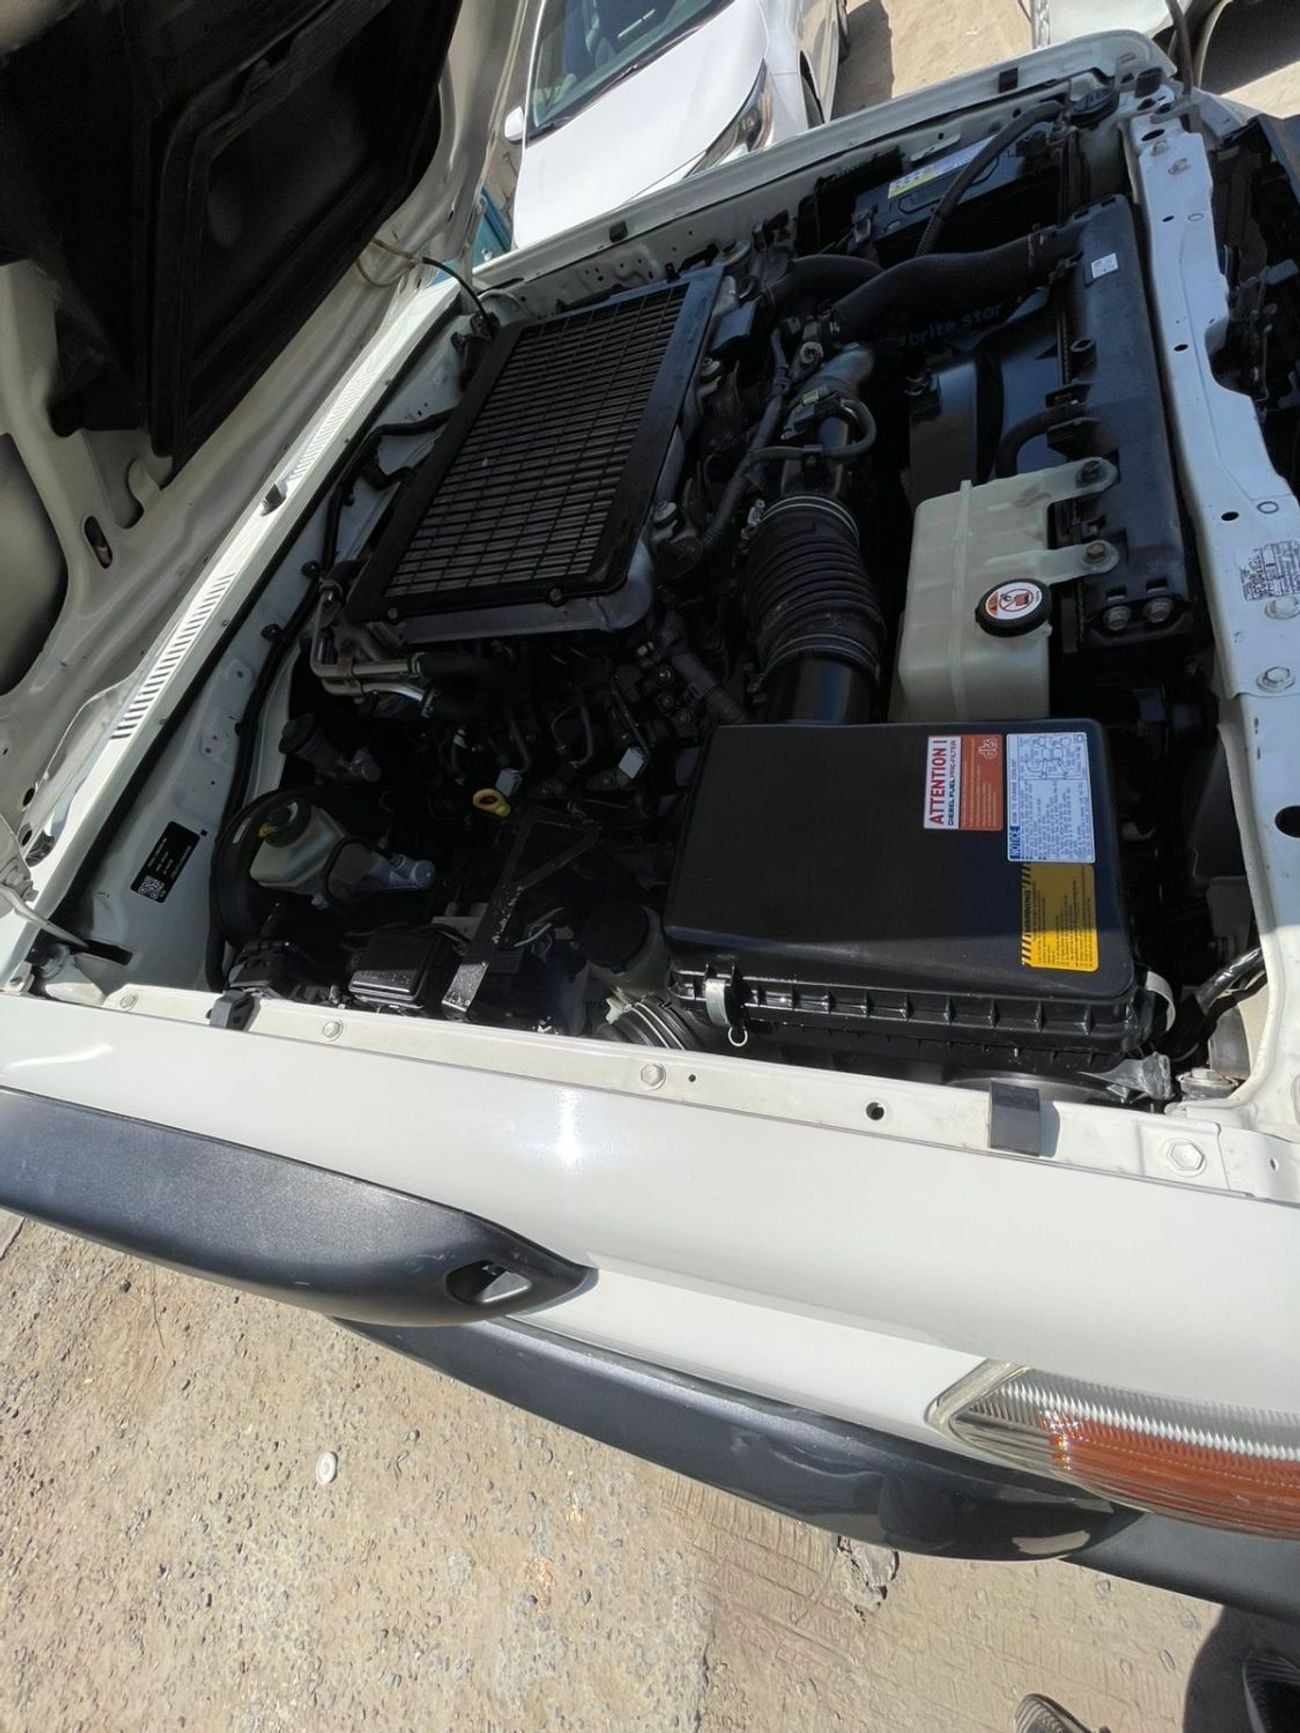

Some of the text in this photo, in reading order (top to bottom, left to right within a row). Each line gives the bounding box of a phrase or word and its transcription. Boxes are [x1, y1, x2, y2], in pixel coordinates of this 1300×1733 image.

[929, 749, 947, 825] ATTENTION
[948, 779, 956, 798] FUEL
[947, 799, 955, 826] DIESEL
[1009, 829, 1020, 858] NOTICE
